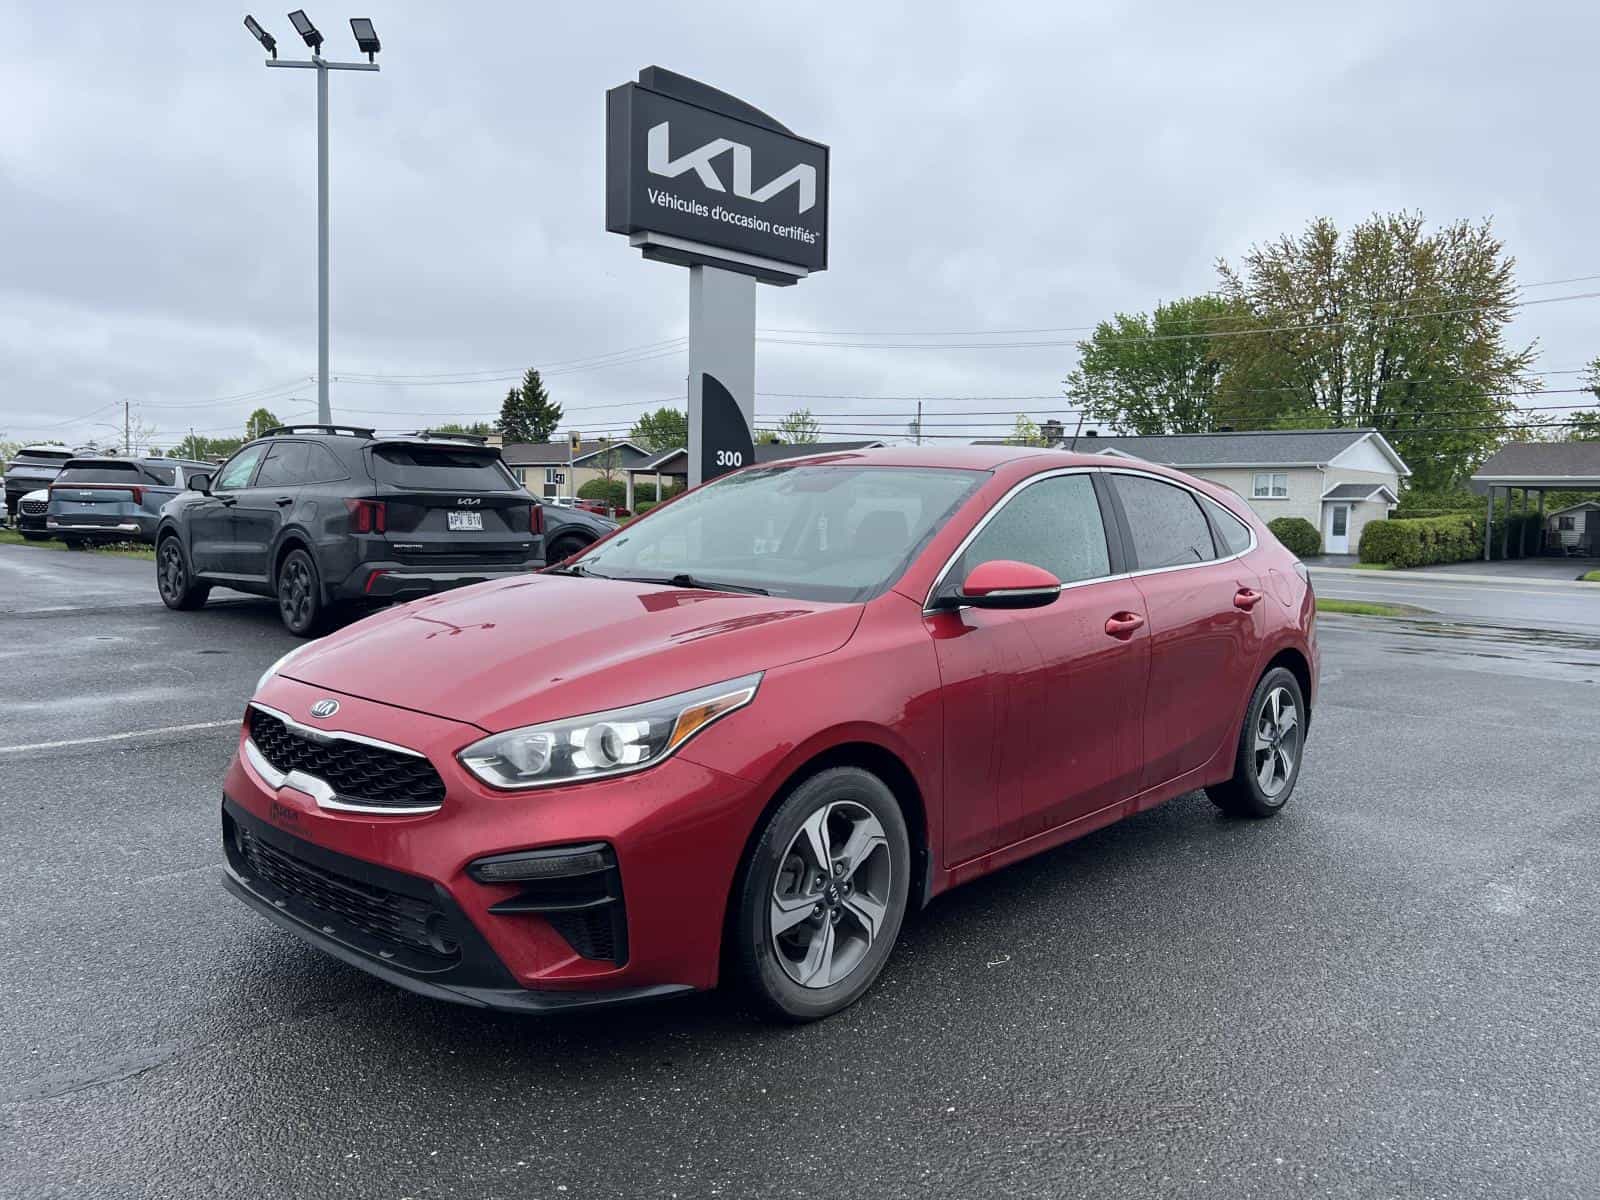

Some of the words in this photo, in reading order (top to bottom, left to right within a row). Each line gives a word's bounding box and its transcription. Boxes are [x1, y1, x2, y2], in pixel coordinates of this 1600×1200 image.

[647, 120, 817, 215] KIA
[648, 187, 709, 217] Véhicules
[711, 205, 771, 233] d'occasion
[716, 450, 743, 467] 300
